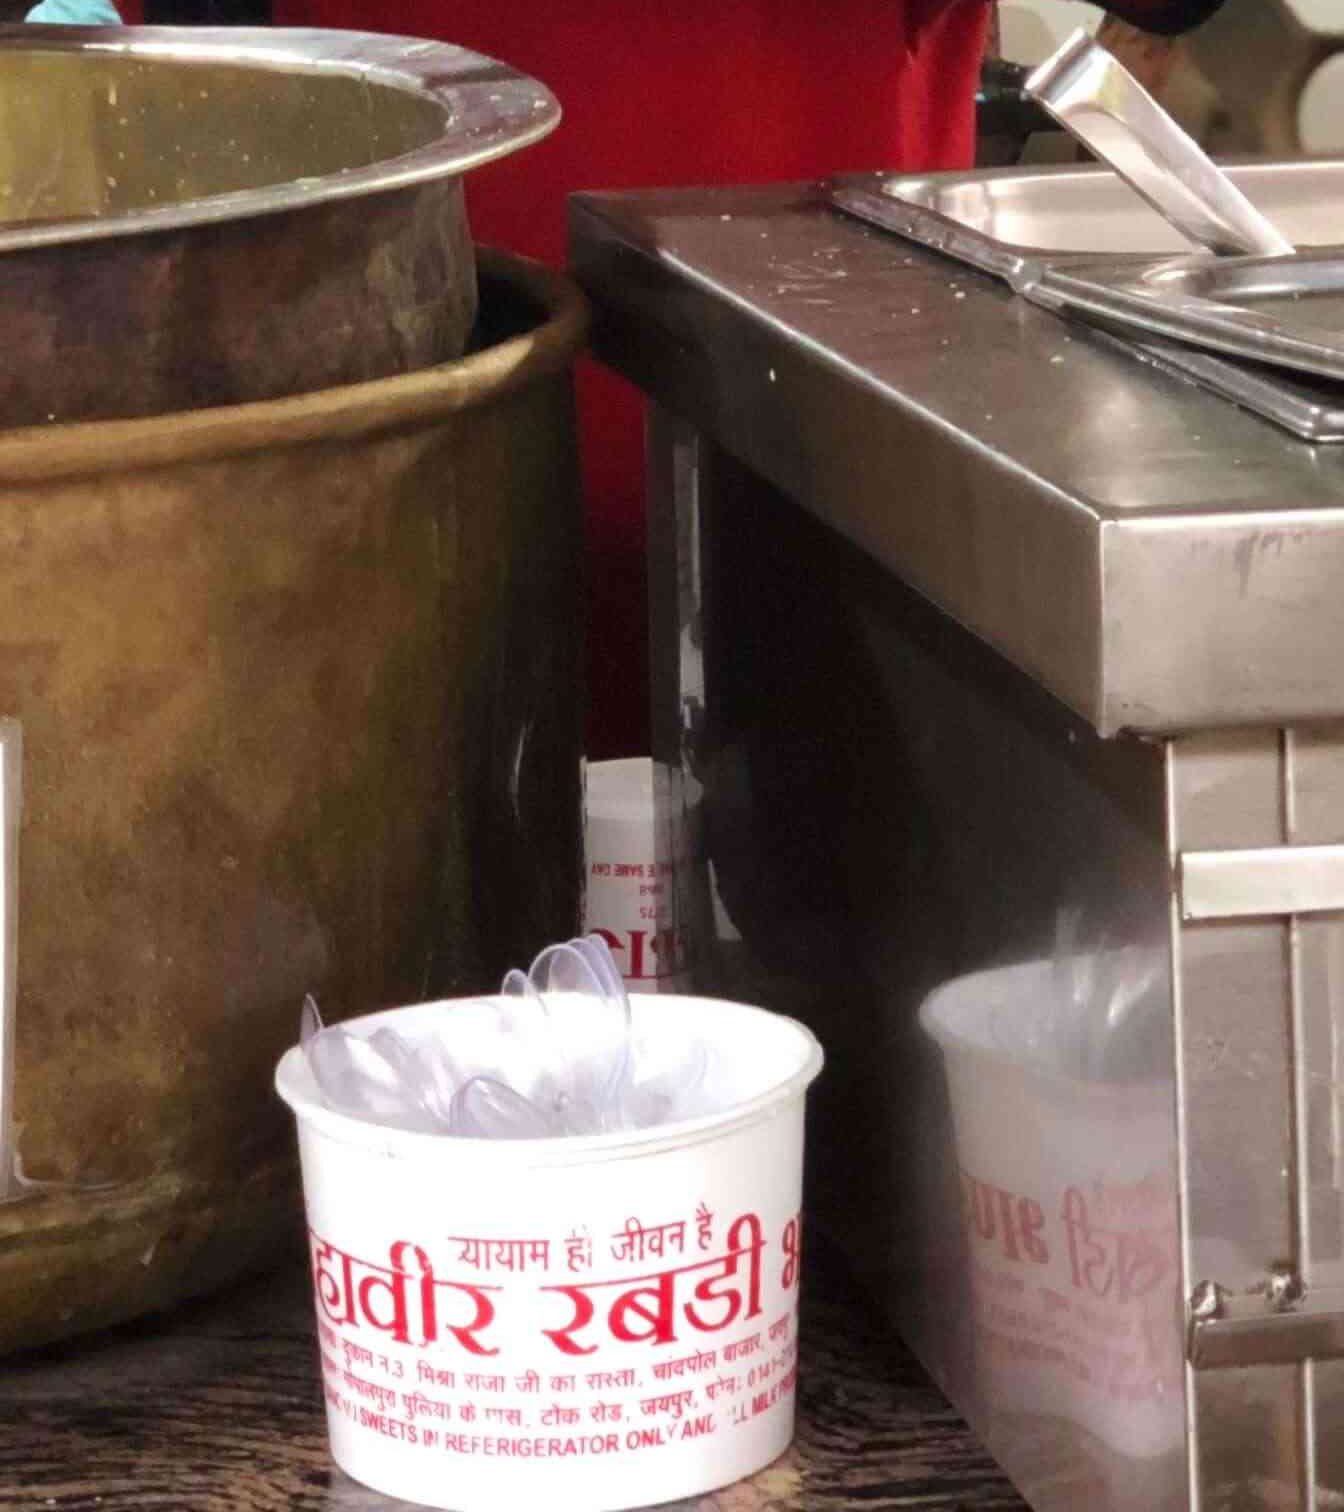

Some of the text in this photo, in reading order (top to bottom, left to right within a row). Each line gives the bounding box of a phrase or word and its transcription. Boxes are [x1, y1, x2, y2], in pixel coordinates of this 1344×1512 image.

[610, 1216, 686, 1263] जीवन
[695, 1201, 713, 1250] है
[309, 1225, 506, 1356] हावीर
[538, 1212, 768, 1356] रबडी
[464, 1375, 506, 1393] राजा
[514, 1368, 540, 1393] जी
[549, 1375, 575, 1392] का
[639, 1390, 698, 1419] जयपुर,
[359, 1406, 418, 1446] SWEETS
[445, 1432, 620, 1458] REFERIGERATOR
